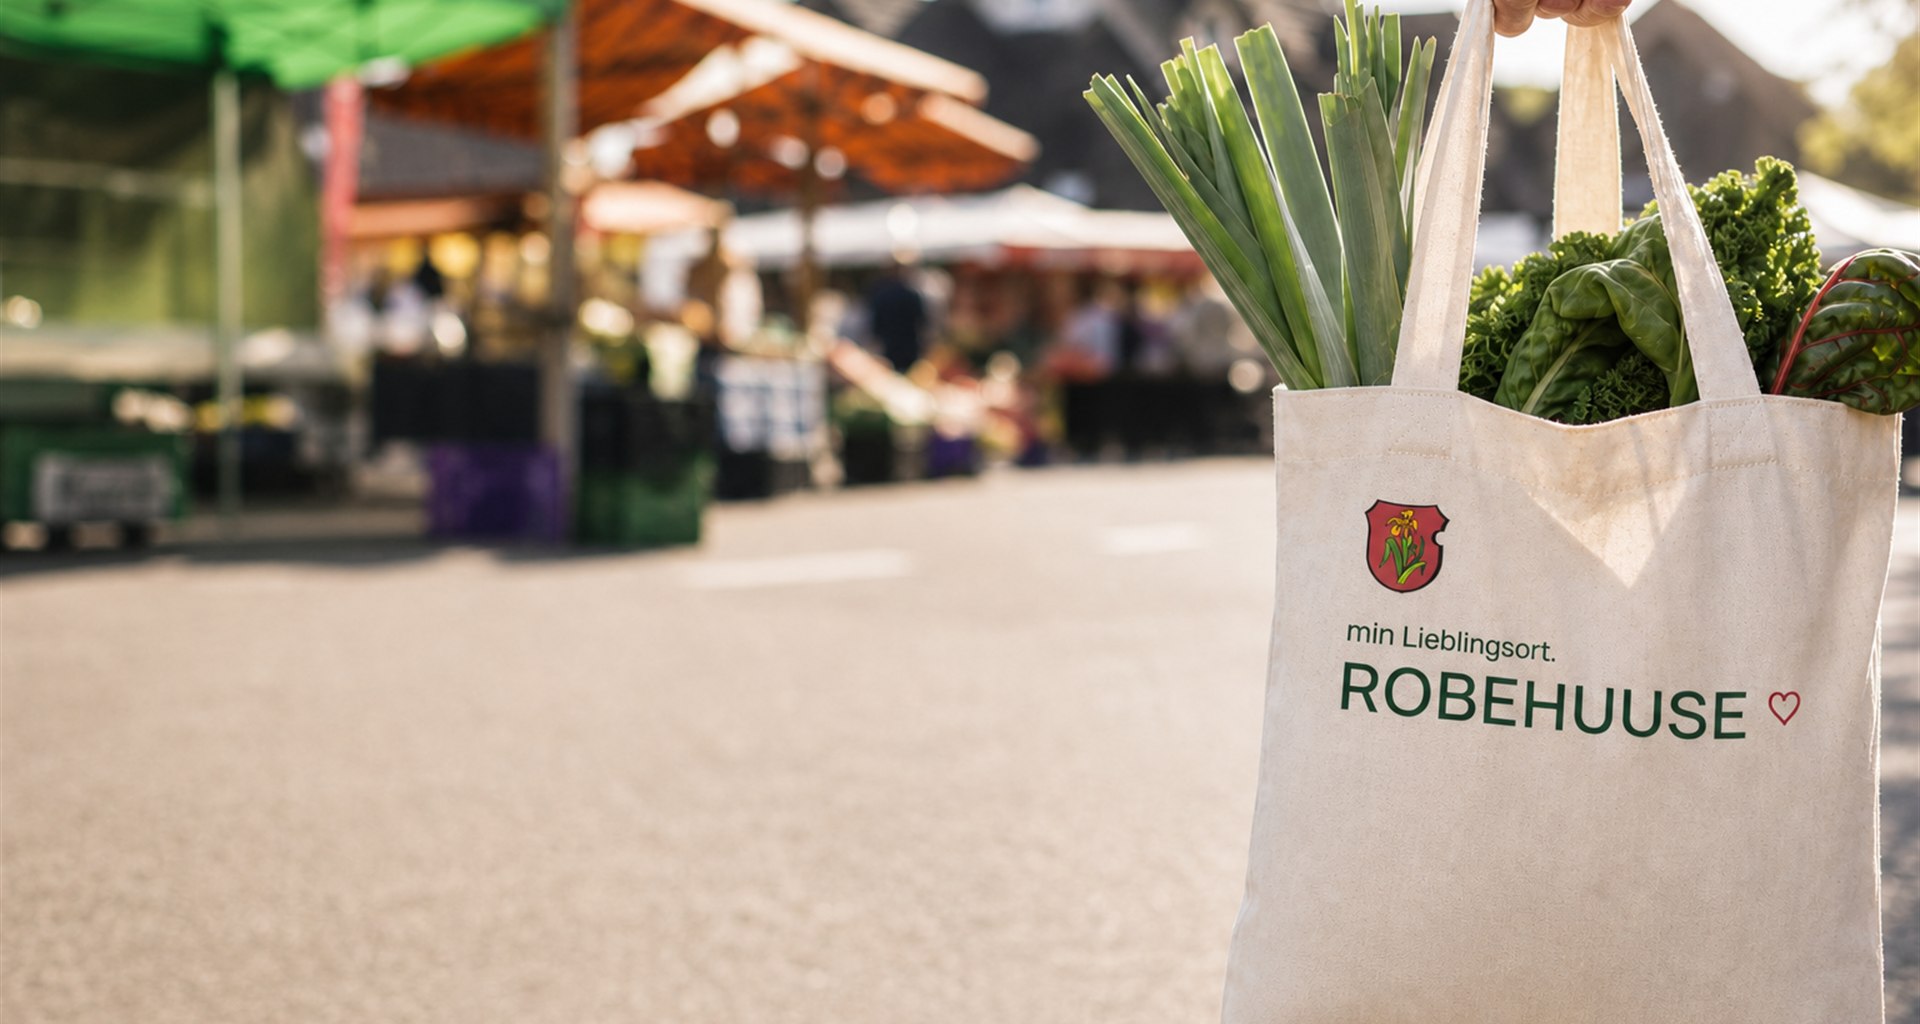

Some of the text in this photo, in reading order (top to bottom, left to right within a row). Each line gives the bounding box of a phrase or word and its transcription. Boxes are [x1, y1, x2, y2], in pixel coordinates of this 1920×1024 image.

[1346, 622, 1556, 663] min Lieblingsort.
[1340, 661, 1747, 740] ROBEHUUSE
